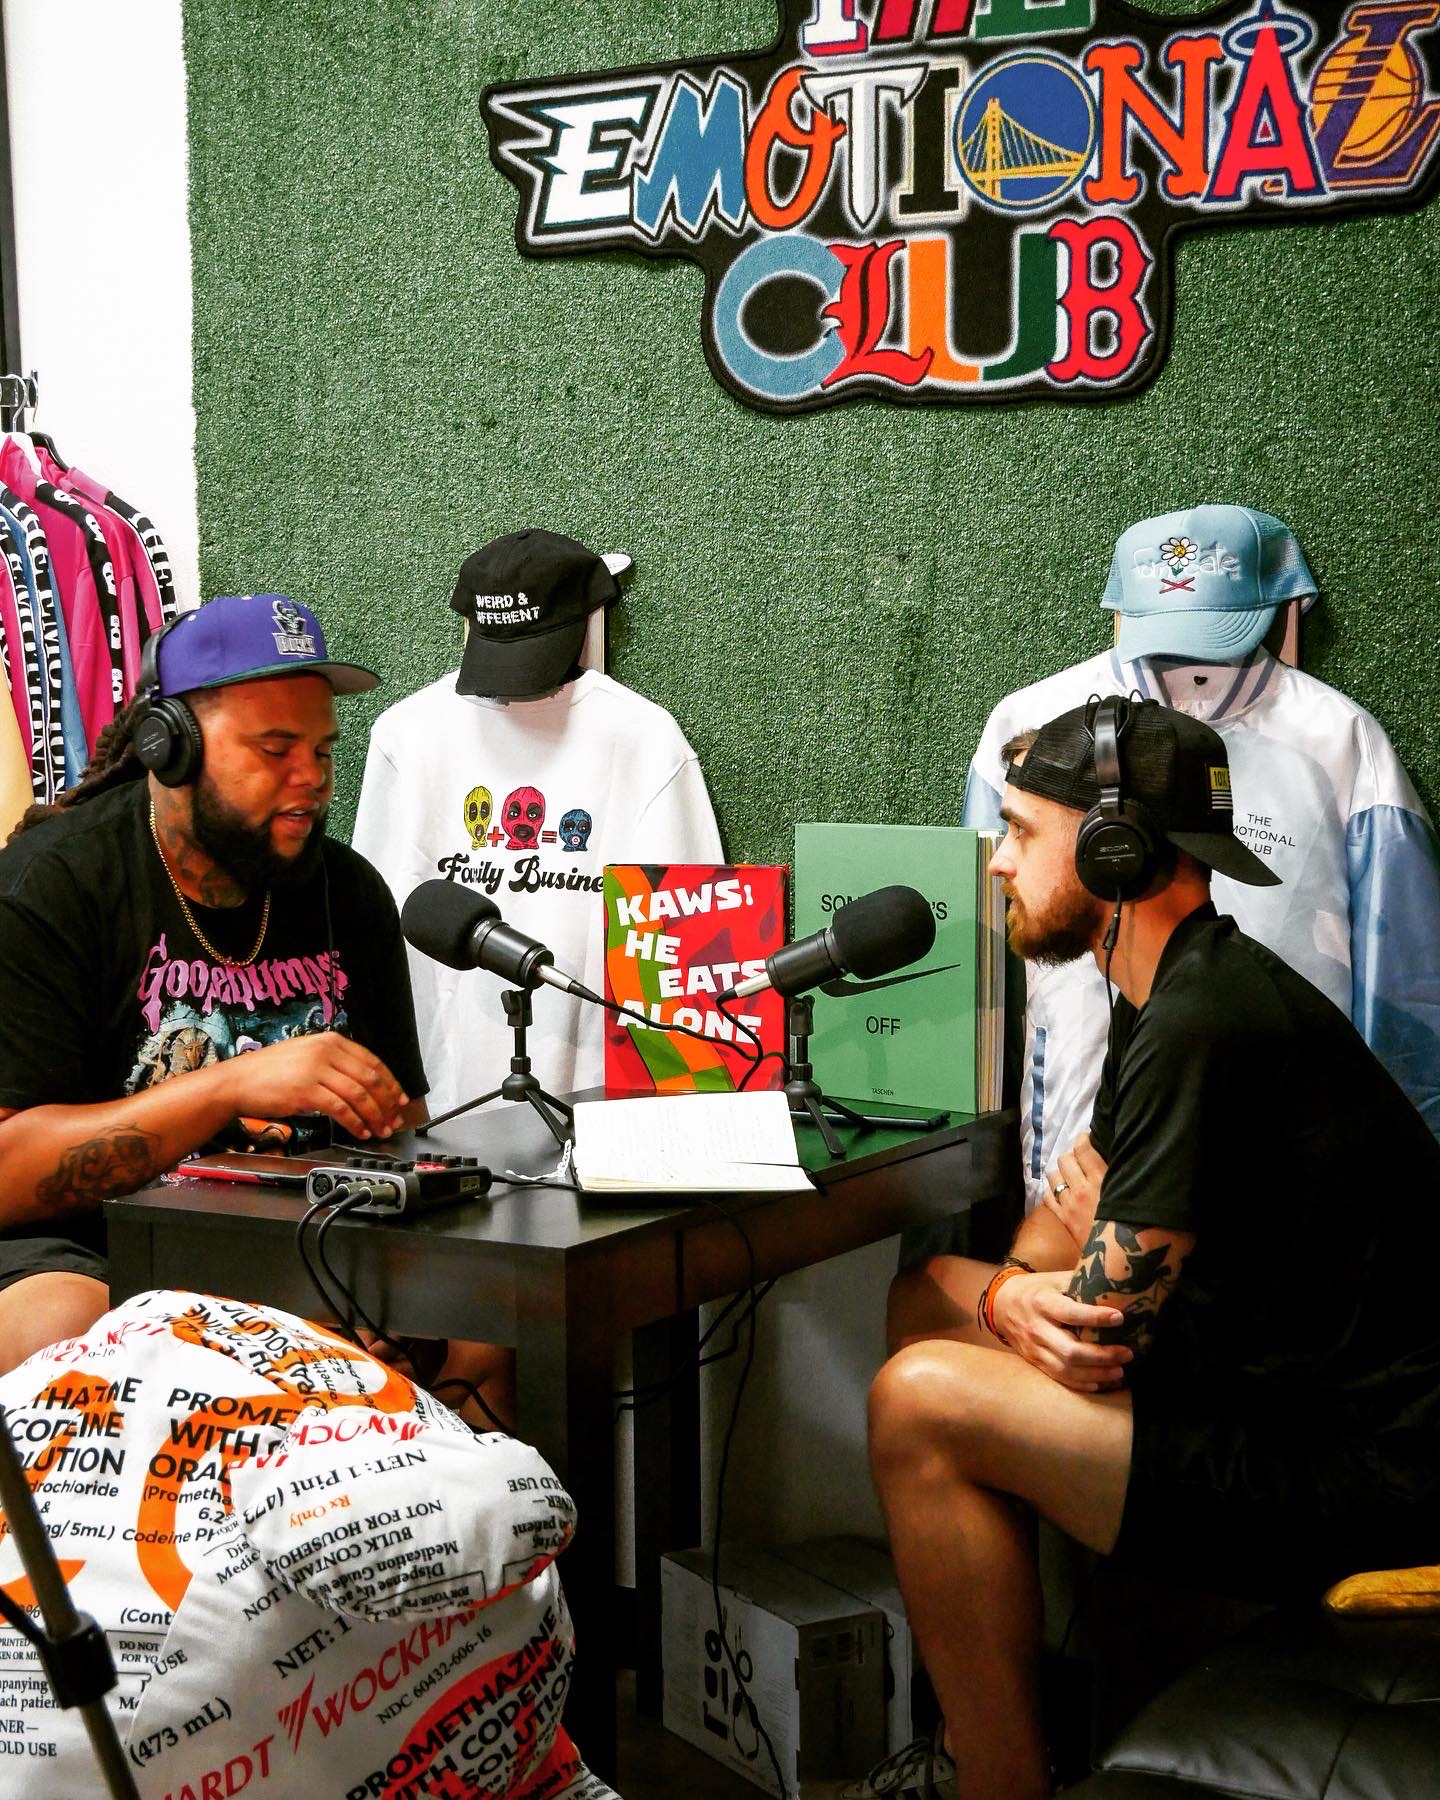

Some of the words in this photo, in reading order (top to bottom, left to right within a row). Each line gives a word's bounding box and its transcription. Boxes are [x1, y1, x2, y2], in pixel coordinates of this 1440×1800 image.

[488, 2, 1440, 243] EMOTIONAL
[711, 216, 1156, 399] CLUB
[475, 593, 514, 609] WEIRD
[517, 592, 529, 605] &
[1247, 813, 1273, 828] THE
[1232, 825, 1296, 848] MOTIONAL
[508, 854, 604, 896] Busine
[624, 929, 682, 965] HE
[616, 999, 763, 1045] ALONE
[866, 1015, 901, 1036] OFF
[871, 1087, 895, 1096] TASCHEN
[169, 1417, 262, 1458] WITH
[351, 1465, 363, 1480] 1
[364, 1448, 428, 1475] NET:
[291, 1469, 342, 1497] Pint
[507, 1478, 537, 1493] USE
[40, 1500, 51, 1514] &
[330, 1494, 351, 1510] Rx
[407, 1498, 444, 1518] NOT
[289, 1506, 327, 1529] Only
[364, 1508, 402, 1532] FOR
[122, 1526, 191, 1545] Codeine
[377, 1526, 414, 1551] BULK
[375, 1539, 459, 1573] Medication
[378, 1561, 446, 1592] Dispense
[242, 1588, 283, 1622] NOT
[119, 1640, 134, 1651] DO
[136, 1641, 160, 1652] NOT
[272, 1627, 337, 1679] NET:
[121, 1653, 141, 1664] FOR
[154, 1649, 189, 1677] USE
[375, 1691, 413, 1726] NDC
[412, 1624, 493, 1698] 60432-606-16
[345, 1612, 560, 1800] PROMETHAZINE
[459, 1637, 566, 1761] CODEINE
[129, 1728, 180, 1767] (473
[183, 1697, 233, 1737] mL)
[28, 1741, 58, 1758] USE
[162, 1734, 275, 1800] ARDT
